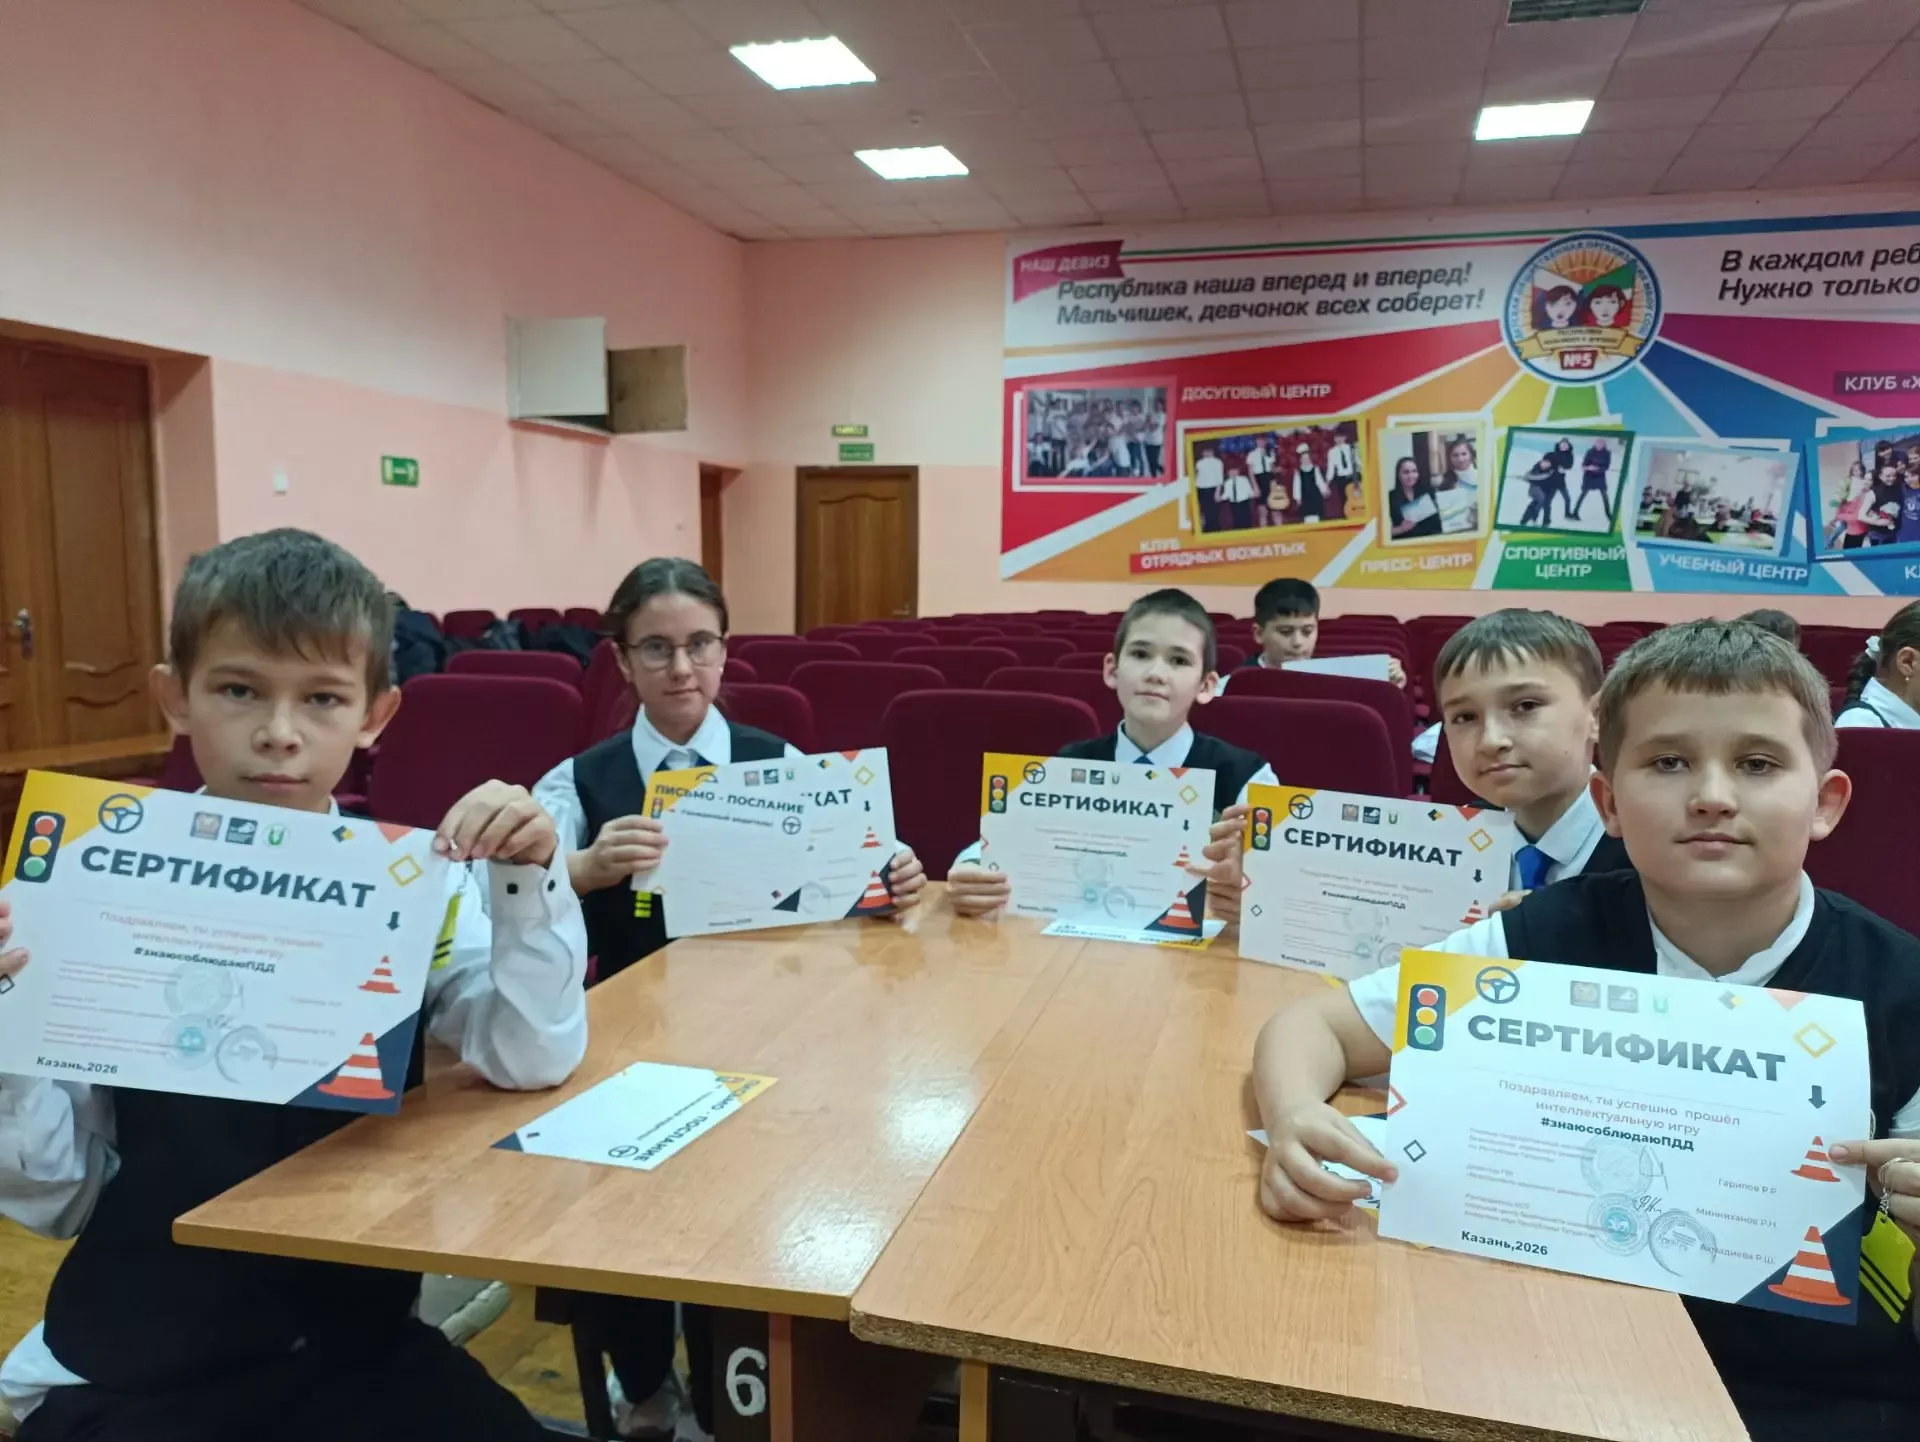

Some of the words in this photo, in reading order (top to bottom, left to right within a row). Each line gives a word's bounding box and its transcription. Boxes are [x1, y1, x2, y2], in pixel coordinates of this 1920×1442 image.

[1720, 250, 1743, 272] В
[1749, 250, 1864, 272] каждом
[1058, 277, 1187, 302] Республика
[1193, 276, 1255, 296] наша
[1262, 271, 1346, 294] вперед
[1353, 271, 1369, 288] и
[1375, 261, 1472, 289] вперед!
[1718, 278, 1813, 306] Нужно
[1823, 276, 1920, 297] только
[1057, 303, 1193, 325] Мальчишек,
[1198, 299, 1309, 322] девчонок
[1315, 298, 1370, 316] всех
[1376, 288, 1485, 316] соберет!
[1182, 383, 1276, 403] ДОСУГОВЫЙ
[1280, 384, 1331, 400] ЦЕНТР
[1845, 375, 1897, 391] КЛУБ
[1505, 544, 1627, 561] СПОРТИВНЫЙ
[1659, 553, 1745, 576] УЧЕБНЫЙ
[1748, 562, 1808, 581] ЦЕНТР
[1535, 564, 1592, 578] ЦЕНТР
[655, 784, 715, 801] ПИСЬМО
[727, 794, 804, 814] ПОСЛАНИЕ
[1019, 791, 1174, 819] СЕРТИФИКАТ
[1284, 827, 1462, 867] СЕРТИФИКАТ
[80, 844, 376, 909] СЕРТИФИКАТ
[1468, 1014, 1786, 1082] СЕРТИФИКАТ
[36, 1055, 119, 1074] Казань,2026
[1499, 1079, 1593, 1104] Поздравляем,
[1596, 1095, 1613, 1107] ты
[1616, 1098, 1678, 1116] успешно
[1685, 1107, 1741, 1126] прошёл
[1535, 1101, 1664, 1130] интеллектуальную
[1667, 1122, 1701, 1137] игру
[1540, 1115, 1695, 1152] #знаюсоблюдаюПДД
[1461, 1230, 1548, 1256] Казань,2026
[726, 1346, 767, 1416] 6
